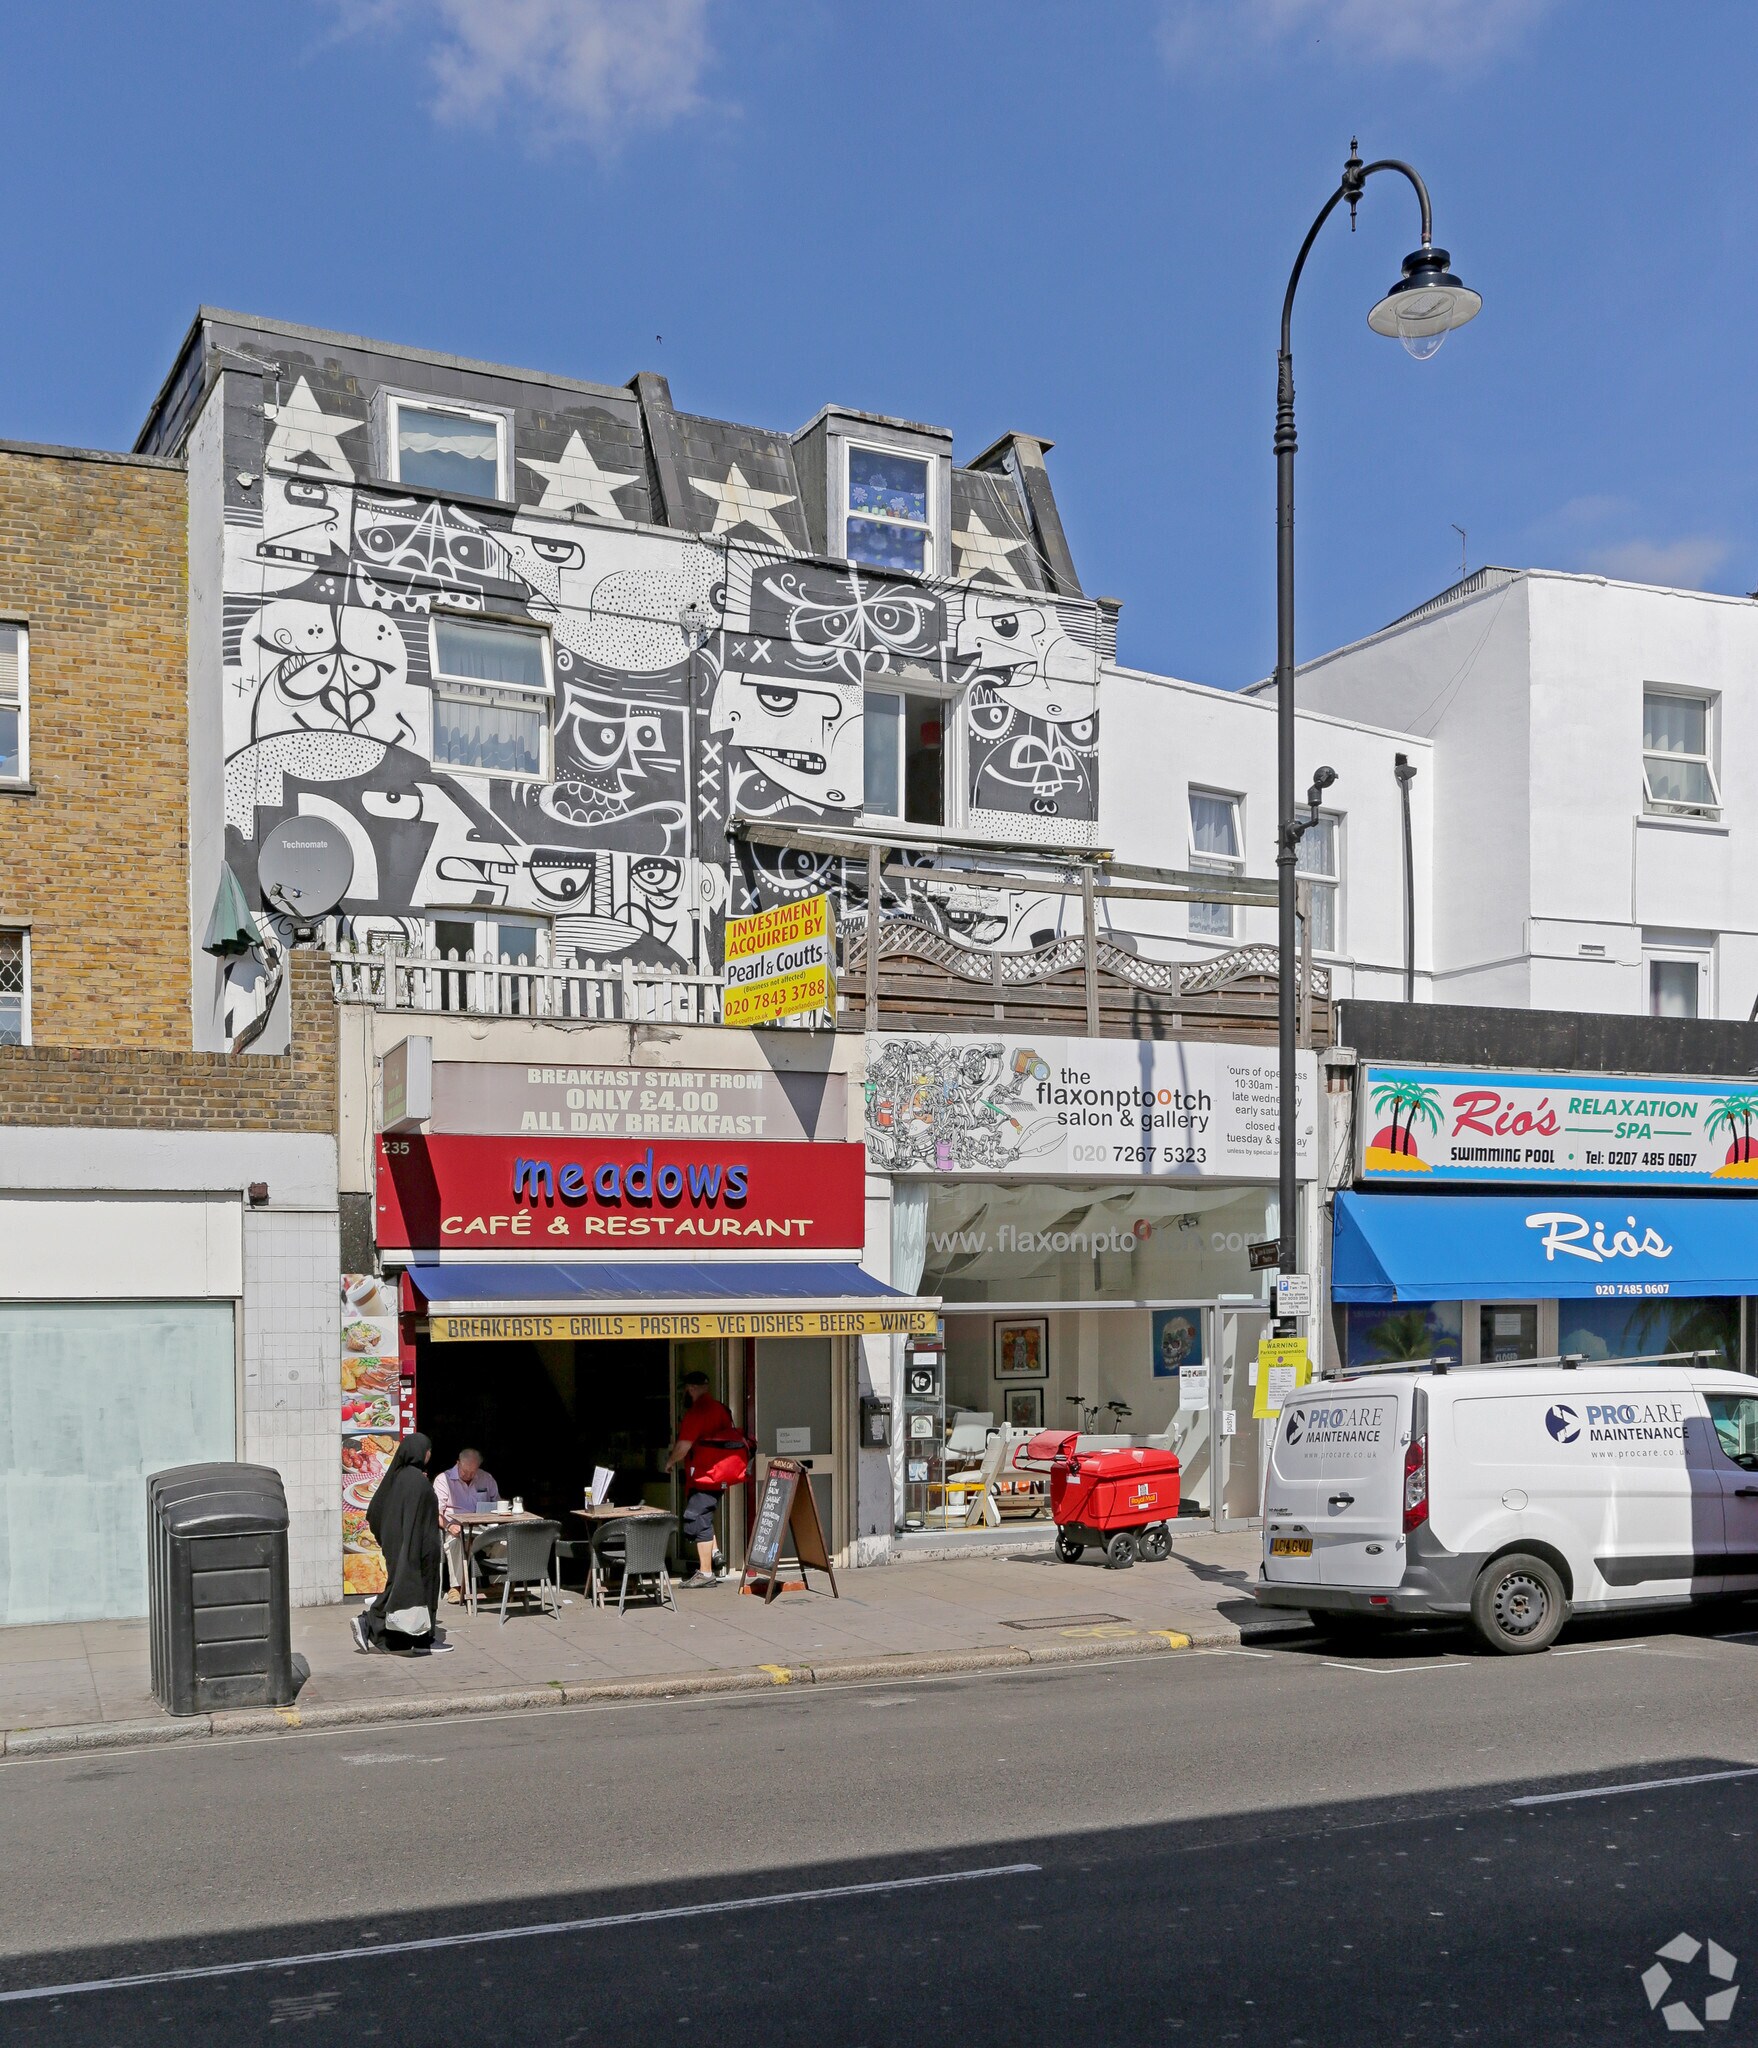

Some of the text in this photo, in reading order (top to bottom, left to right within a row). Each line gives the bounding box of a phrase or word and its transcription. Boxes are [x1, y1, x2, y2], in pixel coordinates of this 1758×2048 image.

[282, 840, 328, 849] Technomate
[733, 899, 819, 938] INVESTMENT
[729, 924, 799, 956] ACQUIRED
[804, 916, 822, 935] BY
[728, 955, 764, 985] Pearl
[766, 961, 774, 975] &
[776, 944, 823, 971] Coutts
[743, 971, 806, 994] (Business not affected)
[725, 979, 825, 1017] 020 7843 3788
[527, 1069, 763, 1089] BREAKFAST START FROM
[1061, 1068, 1091, 1085] the
[1252, 1067, 1262, 1076] of
[566, 1088, 719, 1112] ONLY £4.00
[1036, 1083, 1211, 1112] flaxonptootch
[1232, 1092, 1249, 1102] late
[1235, 1106, 1258, 1117] early
[1451, 1091, 1561, 1137] Rio's
[1568, 1098, 1698, 1118] RELAXATION
[520, 1111, 767, 1134] ALL DAY BREAKFAST
[1057, 1108, 1209, 1133] salon & gallery
[1245, 1121, 1275, 1131] closed
[1227, 1133, 1263, 1146] tuesday
[1265, 1135, 1272, 1144] &
[1614, 1122, 1651, 1140] SPA
[382, 1142, 410, 1155] 235
[1073, 1145, 1207, 1163] 020 7267 5323
[1450, 1146, 1697, 1167] SWIMMING POOL Tel: 0207 485 0607
[513, 1147, 748, 1199] meadows
[441, 1209, 814, 1237] CAFÉ & RESTAURANT
[1525, 1212, 1673, 1263] Rio's
[1595, 1284, 1669, 1295] 020 7485 0607
[448, 1318, 553, 1338] BREAKFASTS
[570, 1317, 623, 1335] GRILLS
[641, 1316, 700, 1335] PASTAS
[717, 1316, 745, 1333] VEG
[751, 1314, 804, 1333] DISHES
[820, 1314, 865, 1331] BEERS
[880, 1313, 926, 1331] WINES
[1225, 1412, 1234, 1432] pushy
[1306, 1430, 1380, 1443] MAINTENANCE
[1590, 1426, 1689, 1441] MAINTENANCE
[1304, 1450, 1377, 1459] www.procare.co.uk
[1591, 1449, 1691, 1458] www.procare.co.uk
[1131, 1497, 1145, 1505] Royal
